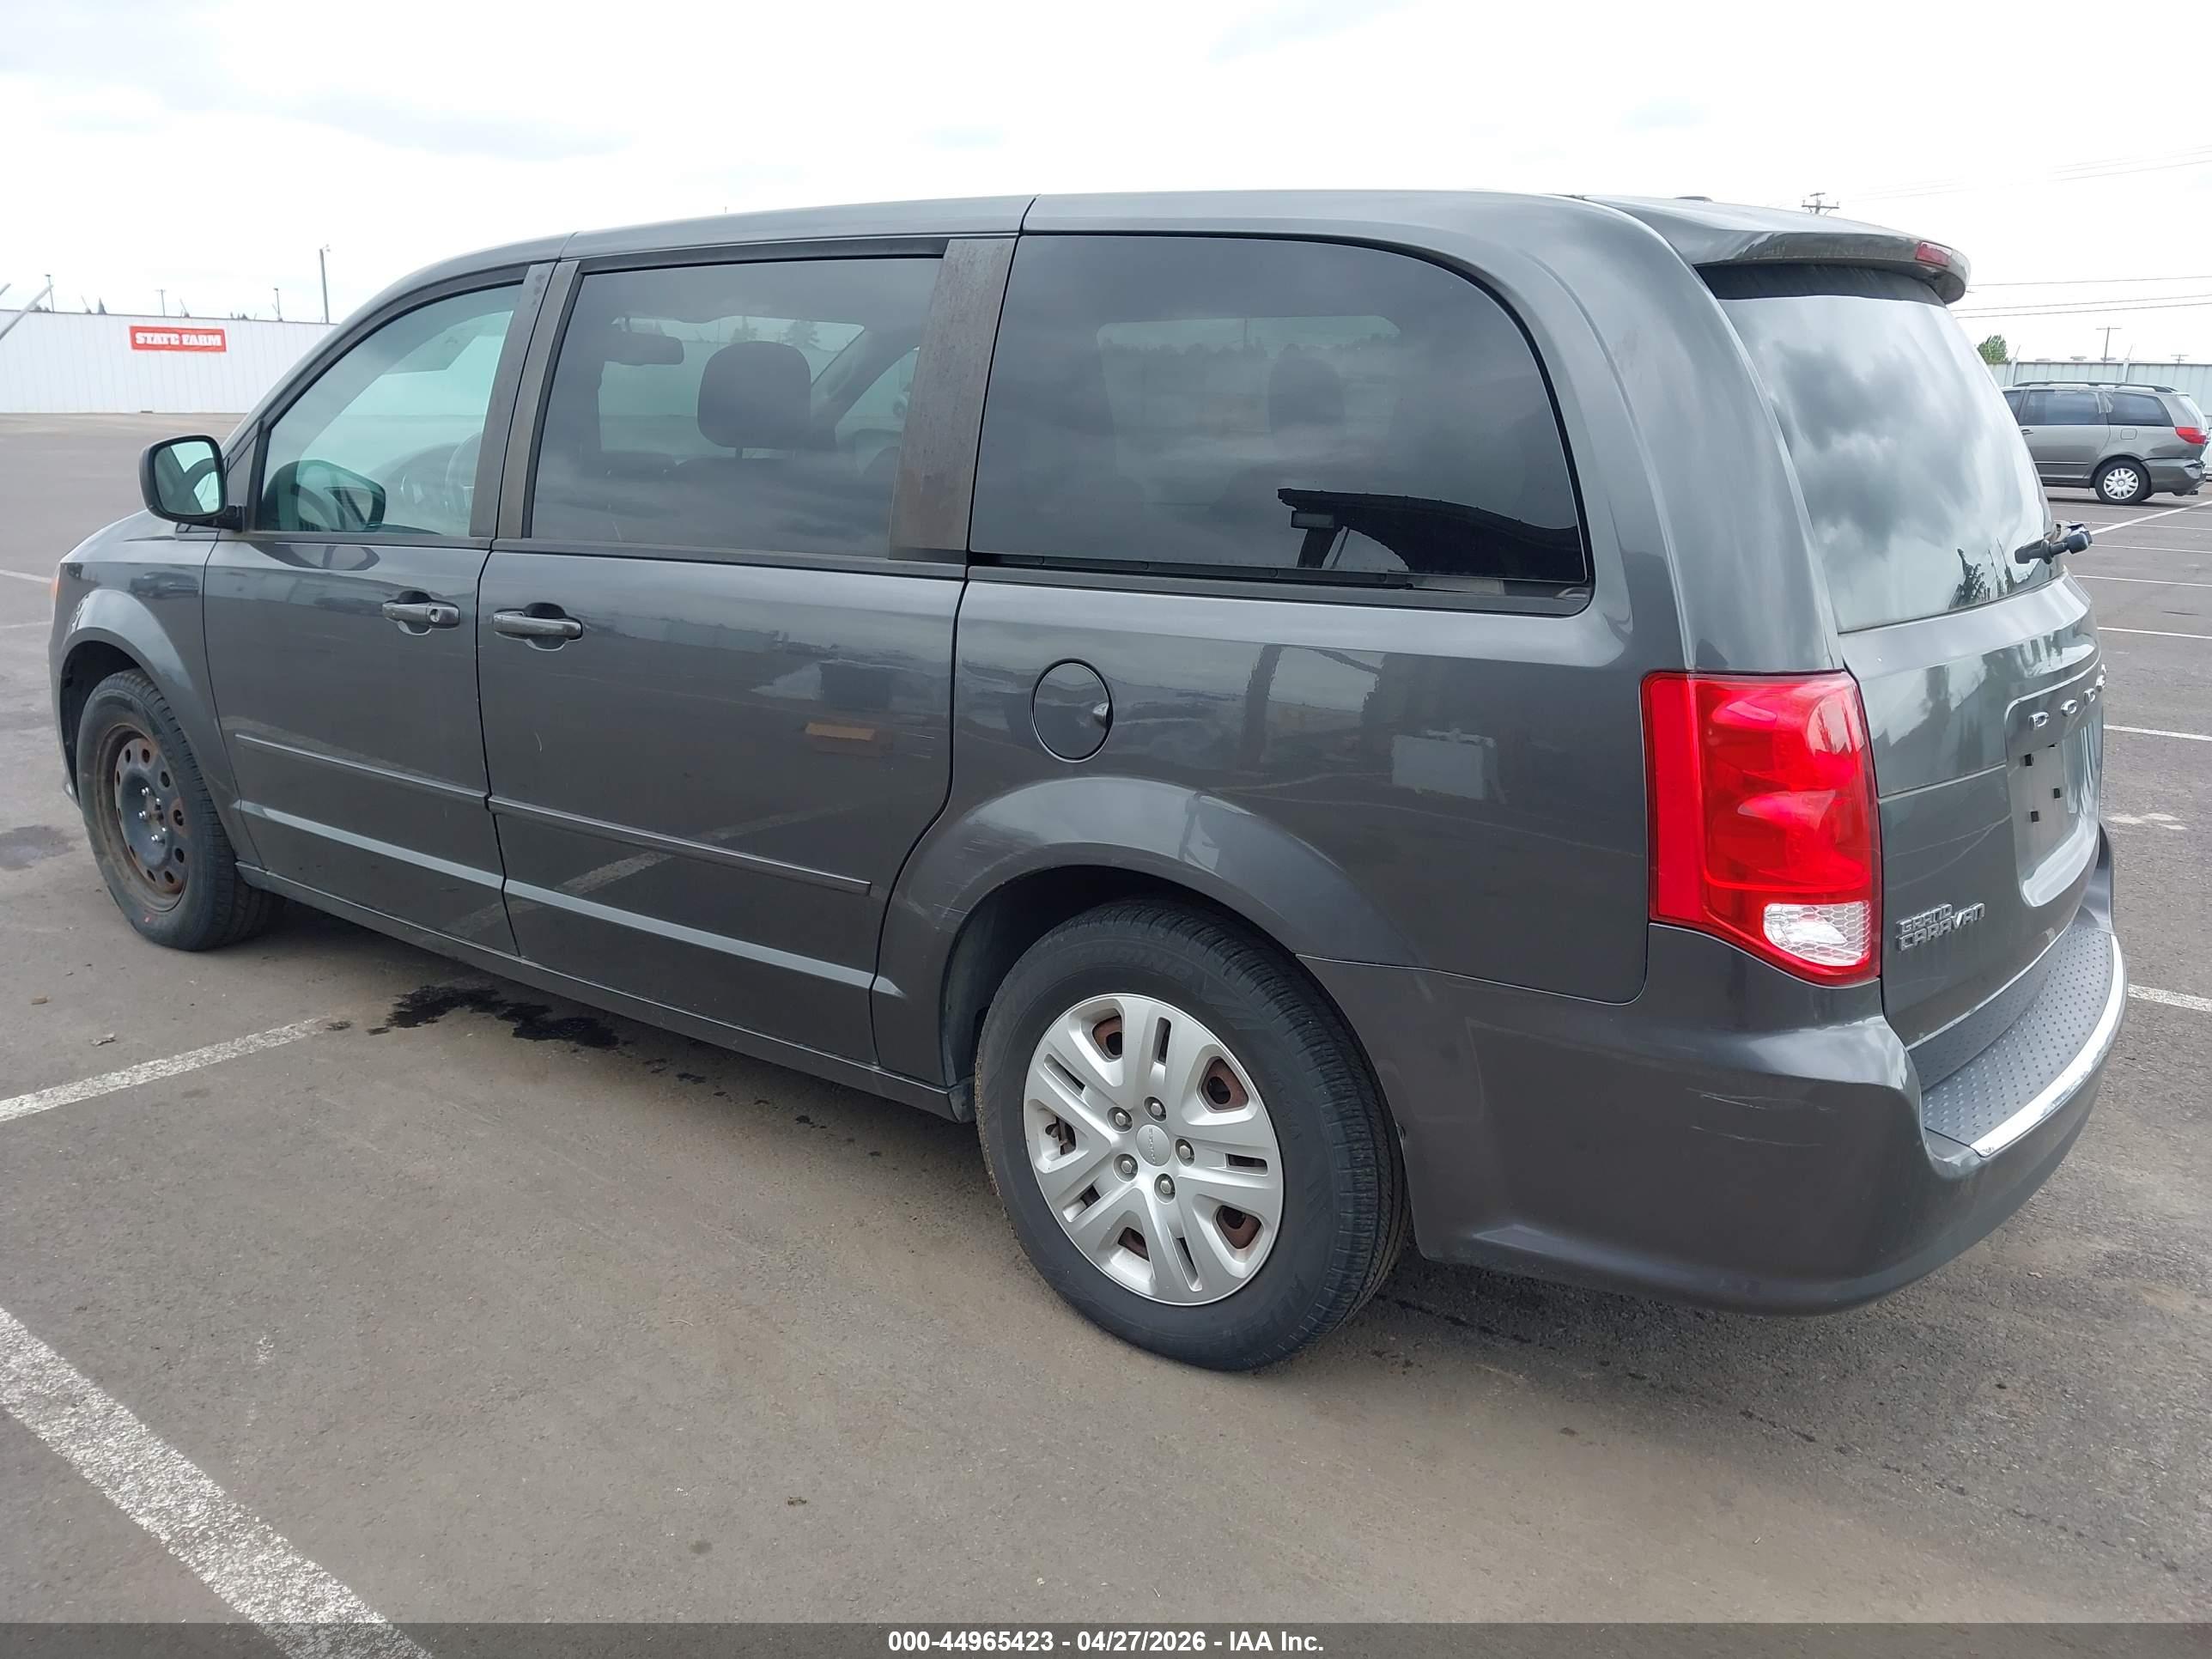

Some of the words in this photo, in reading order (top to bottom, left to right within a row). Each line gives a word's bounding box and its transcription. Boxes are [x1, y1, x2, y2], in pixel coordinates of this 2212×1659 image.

[135, 332, 179, 345] STATE
[180, 333, 222, 347] FARM
[2028, 664, 2106, 731] DOD
[1896, 903, 1953, 935] GRAND
[1896, 902, 1985, 952] CARAVAN
